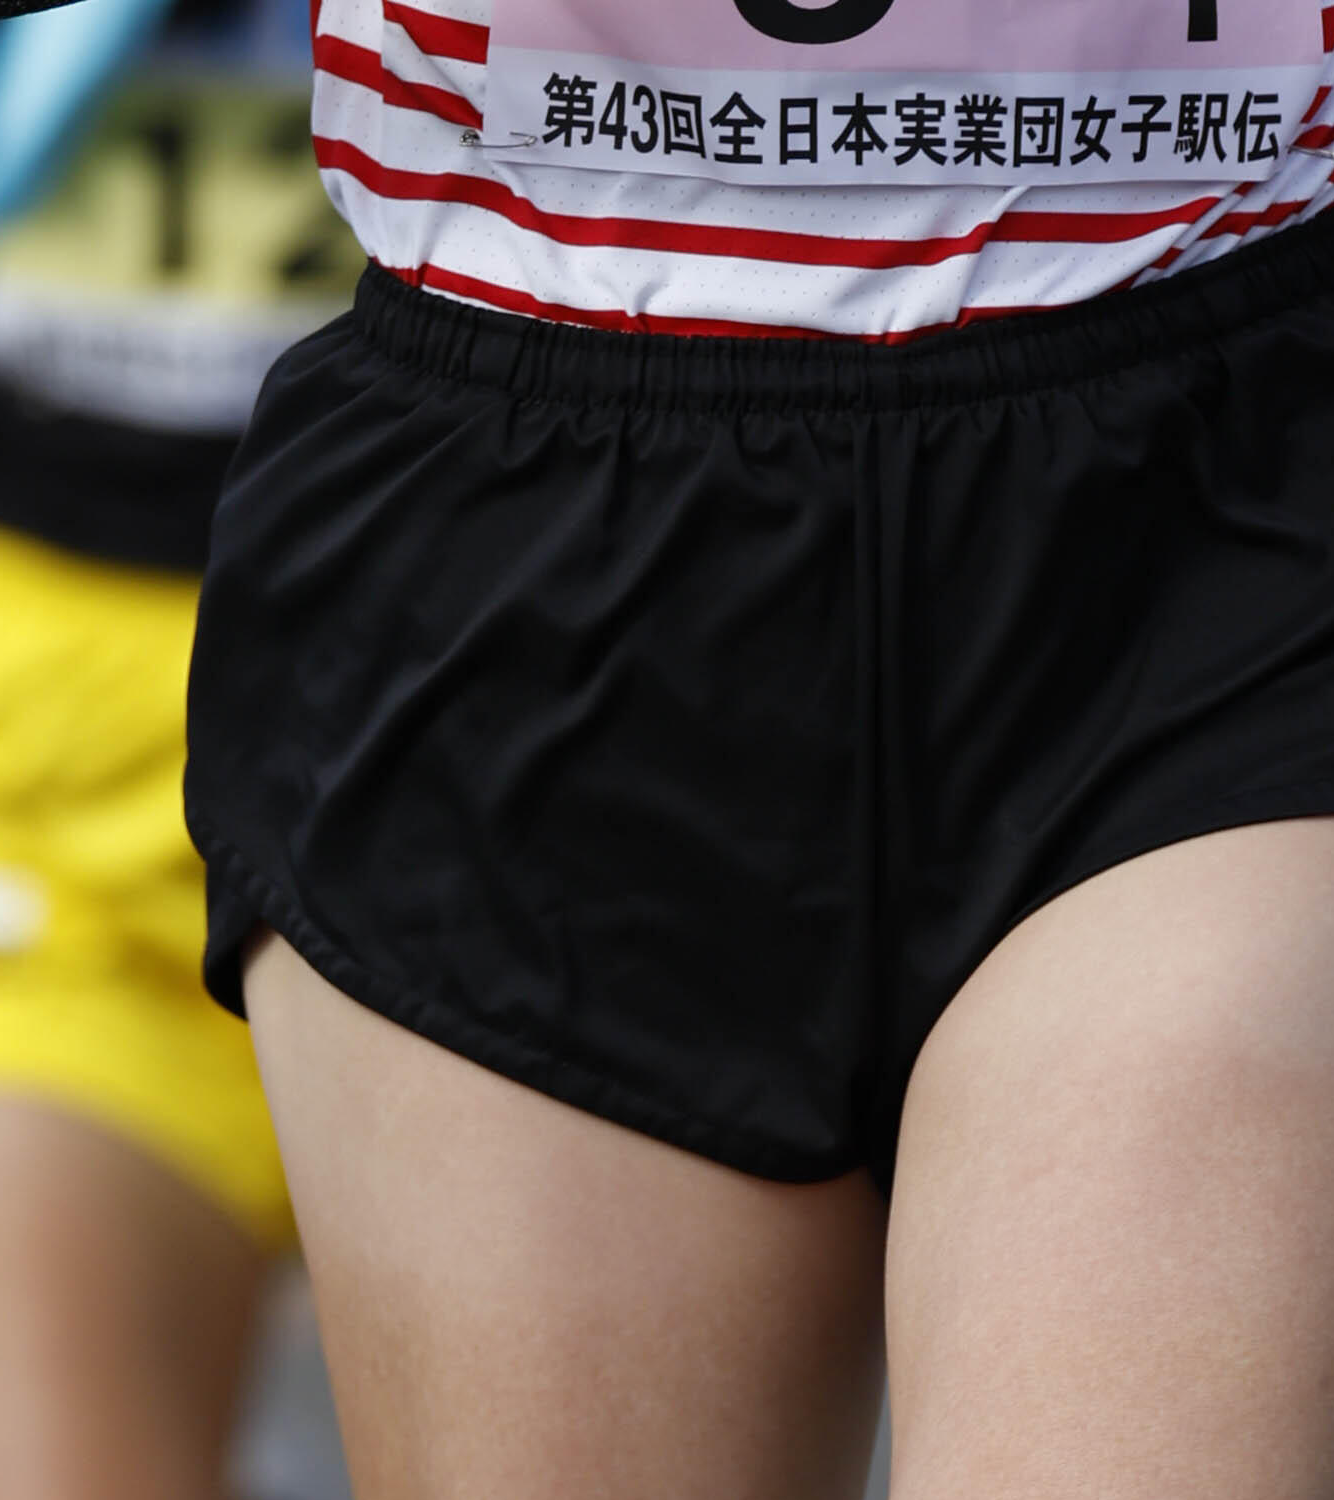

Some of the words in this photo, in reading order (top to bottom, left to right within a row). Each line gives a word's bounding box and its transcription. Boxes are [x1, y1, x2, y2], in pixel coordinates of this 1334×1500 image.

[541, 70, 1282, 168] 第43回全日本実業団女子駅伝
